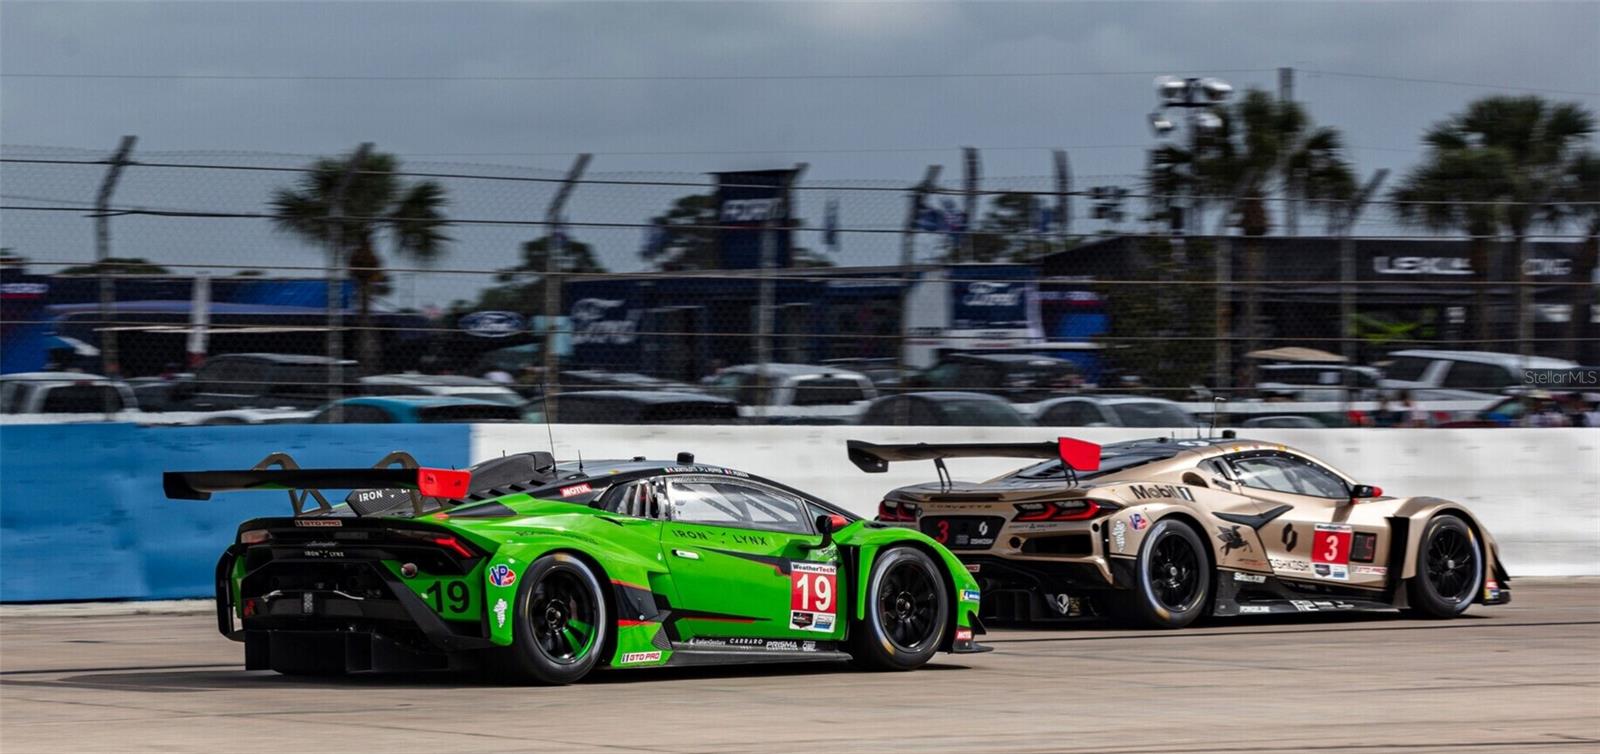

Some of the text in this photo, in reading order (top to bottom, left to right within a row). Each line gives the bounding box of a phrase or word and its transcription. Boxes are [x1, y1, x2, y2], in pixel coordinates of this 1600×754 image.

[359, 490, 383, 502] IRON
[562, 485, 589, 497] MOTUL
[1129, 484, 1178, 500] Mobil
[672, 529, 768, 546] IRON LYNX
[936, 520, 950, 544] 3
[1324, 535, 1339, 561] 3
[427, 580, 470, 614] 19
[797, 574, 832, 612] 19
